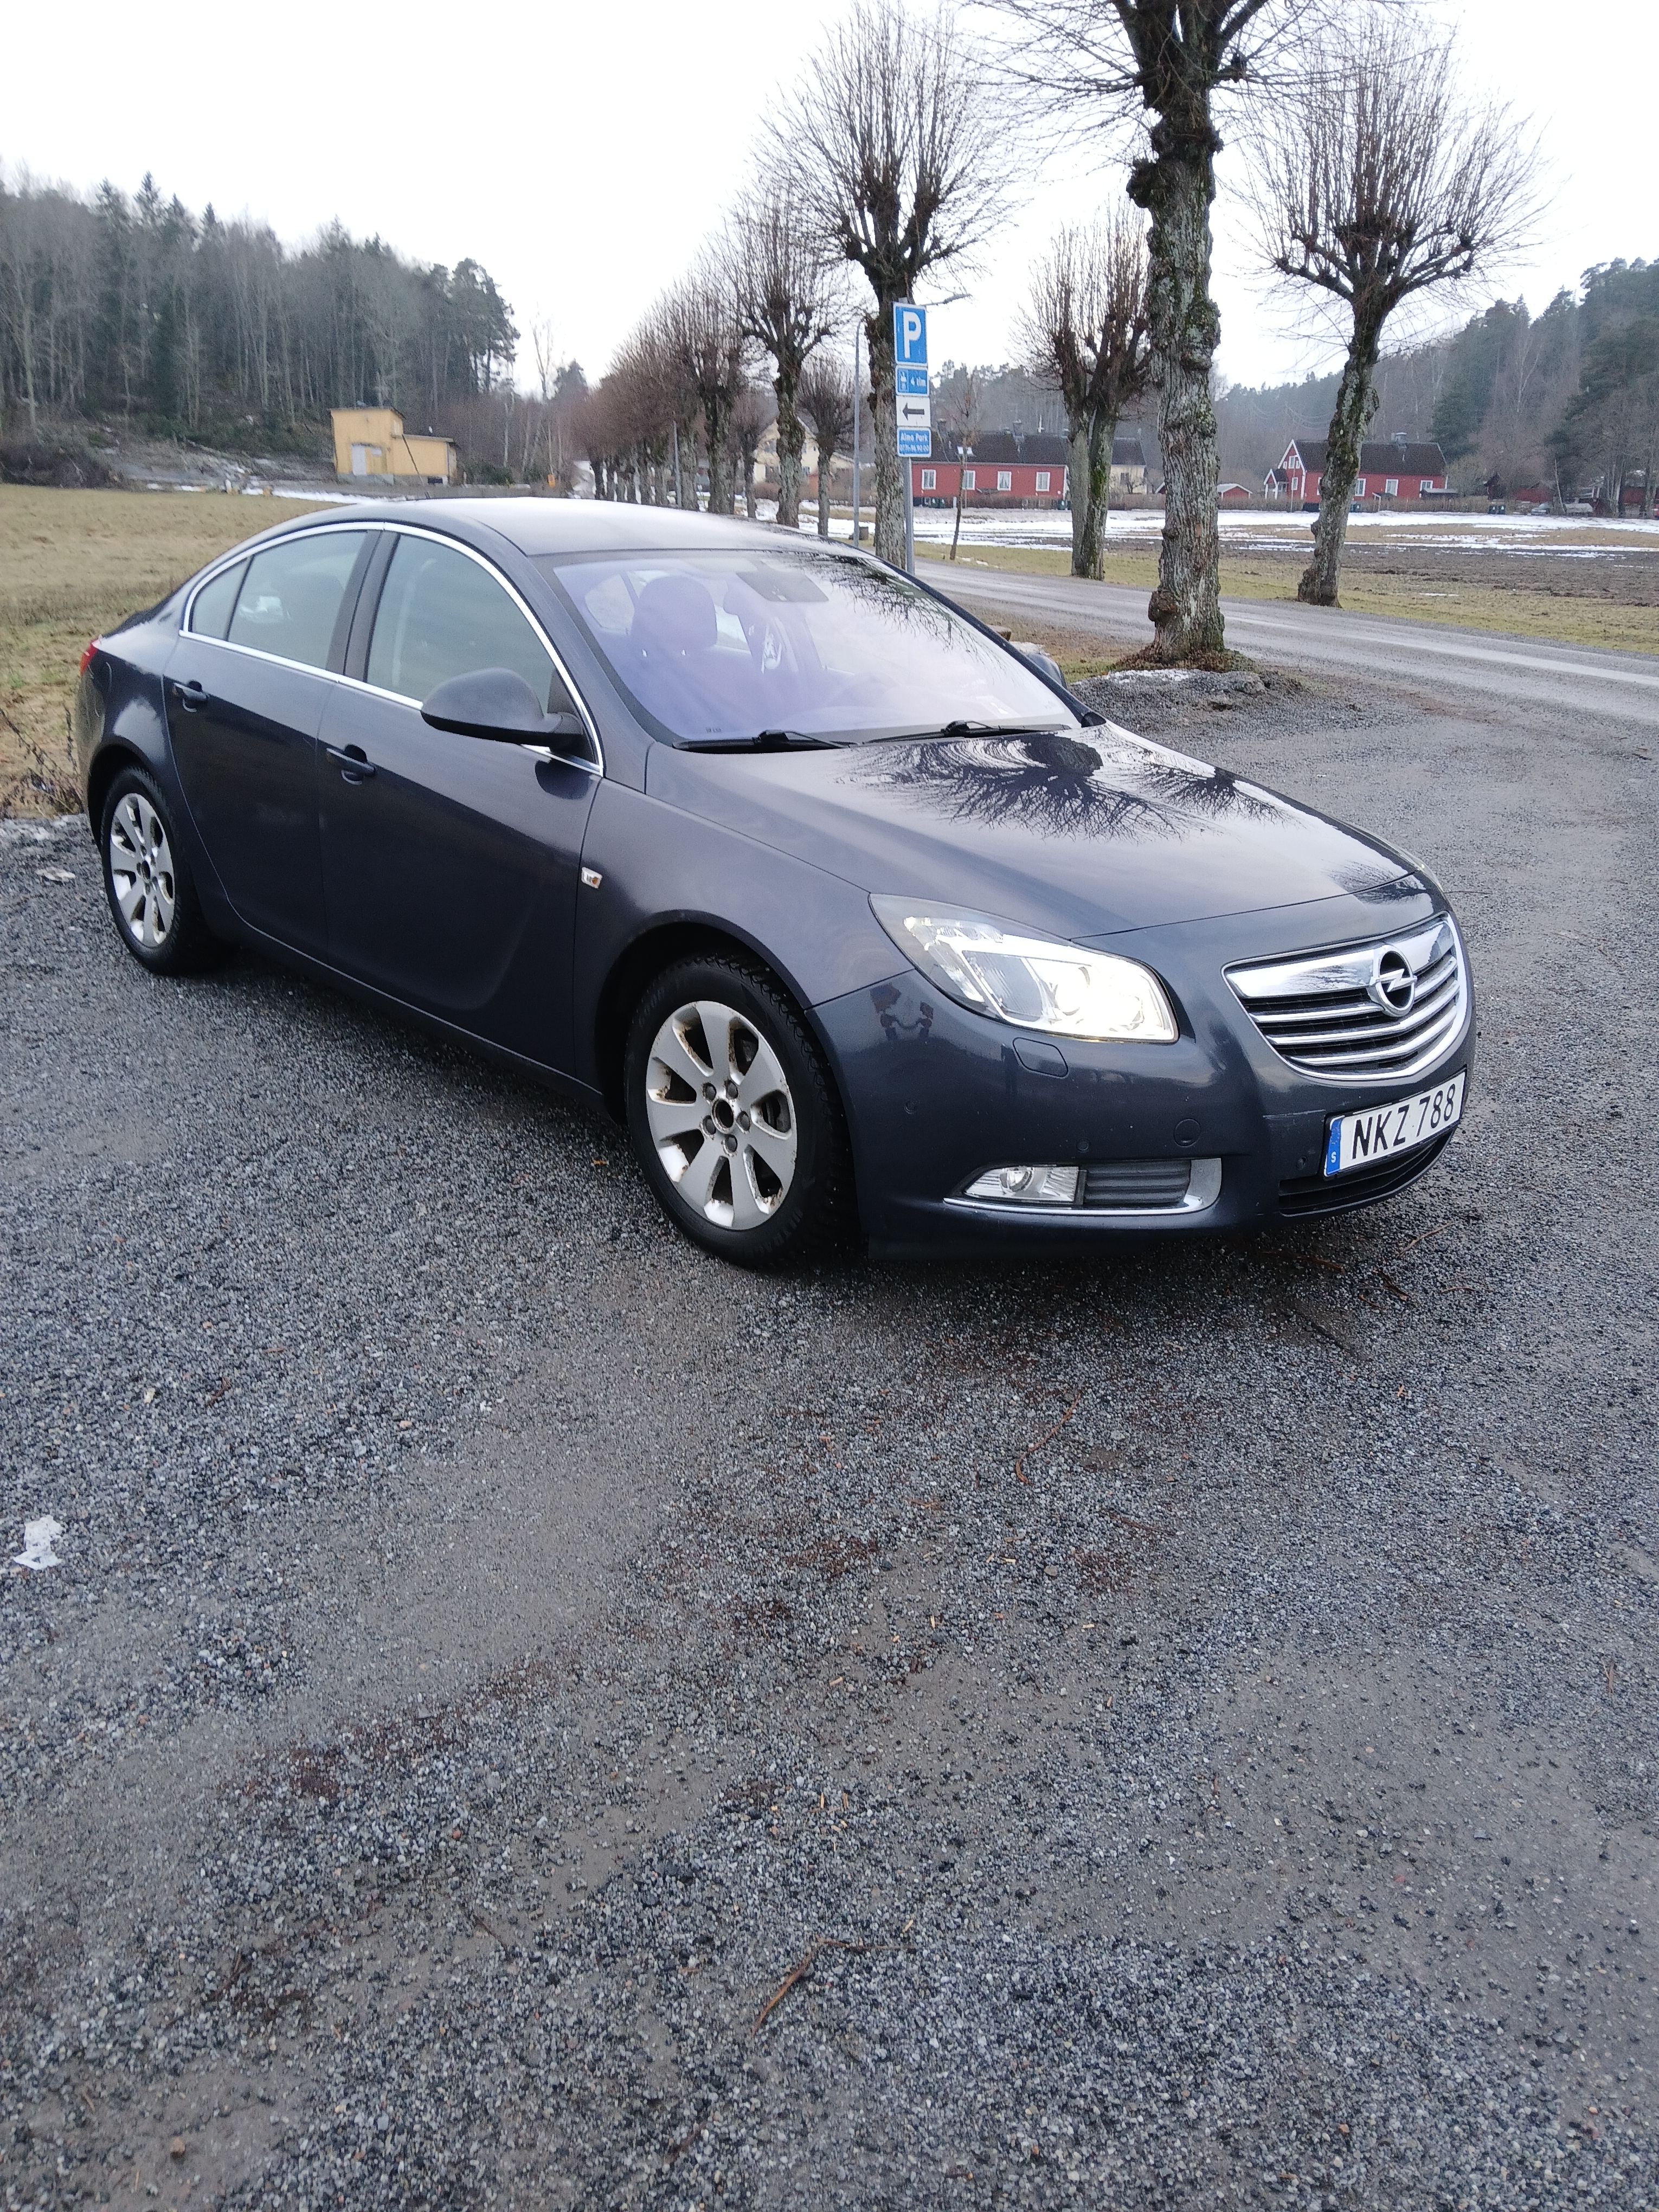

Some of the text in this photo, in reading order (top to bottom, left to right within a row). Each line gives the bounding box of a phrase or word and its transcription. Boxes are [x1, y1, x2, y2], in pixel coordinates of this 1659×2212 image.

[903, 310, 922, 359] P
[916, 433, 928, 442] Park
[1352, 1083, 1456, 1160] NKZ 788
[1330, 1151, 1336, 1163] S
